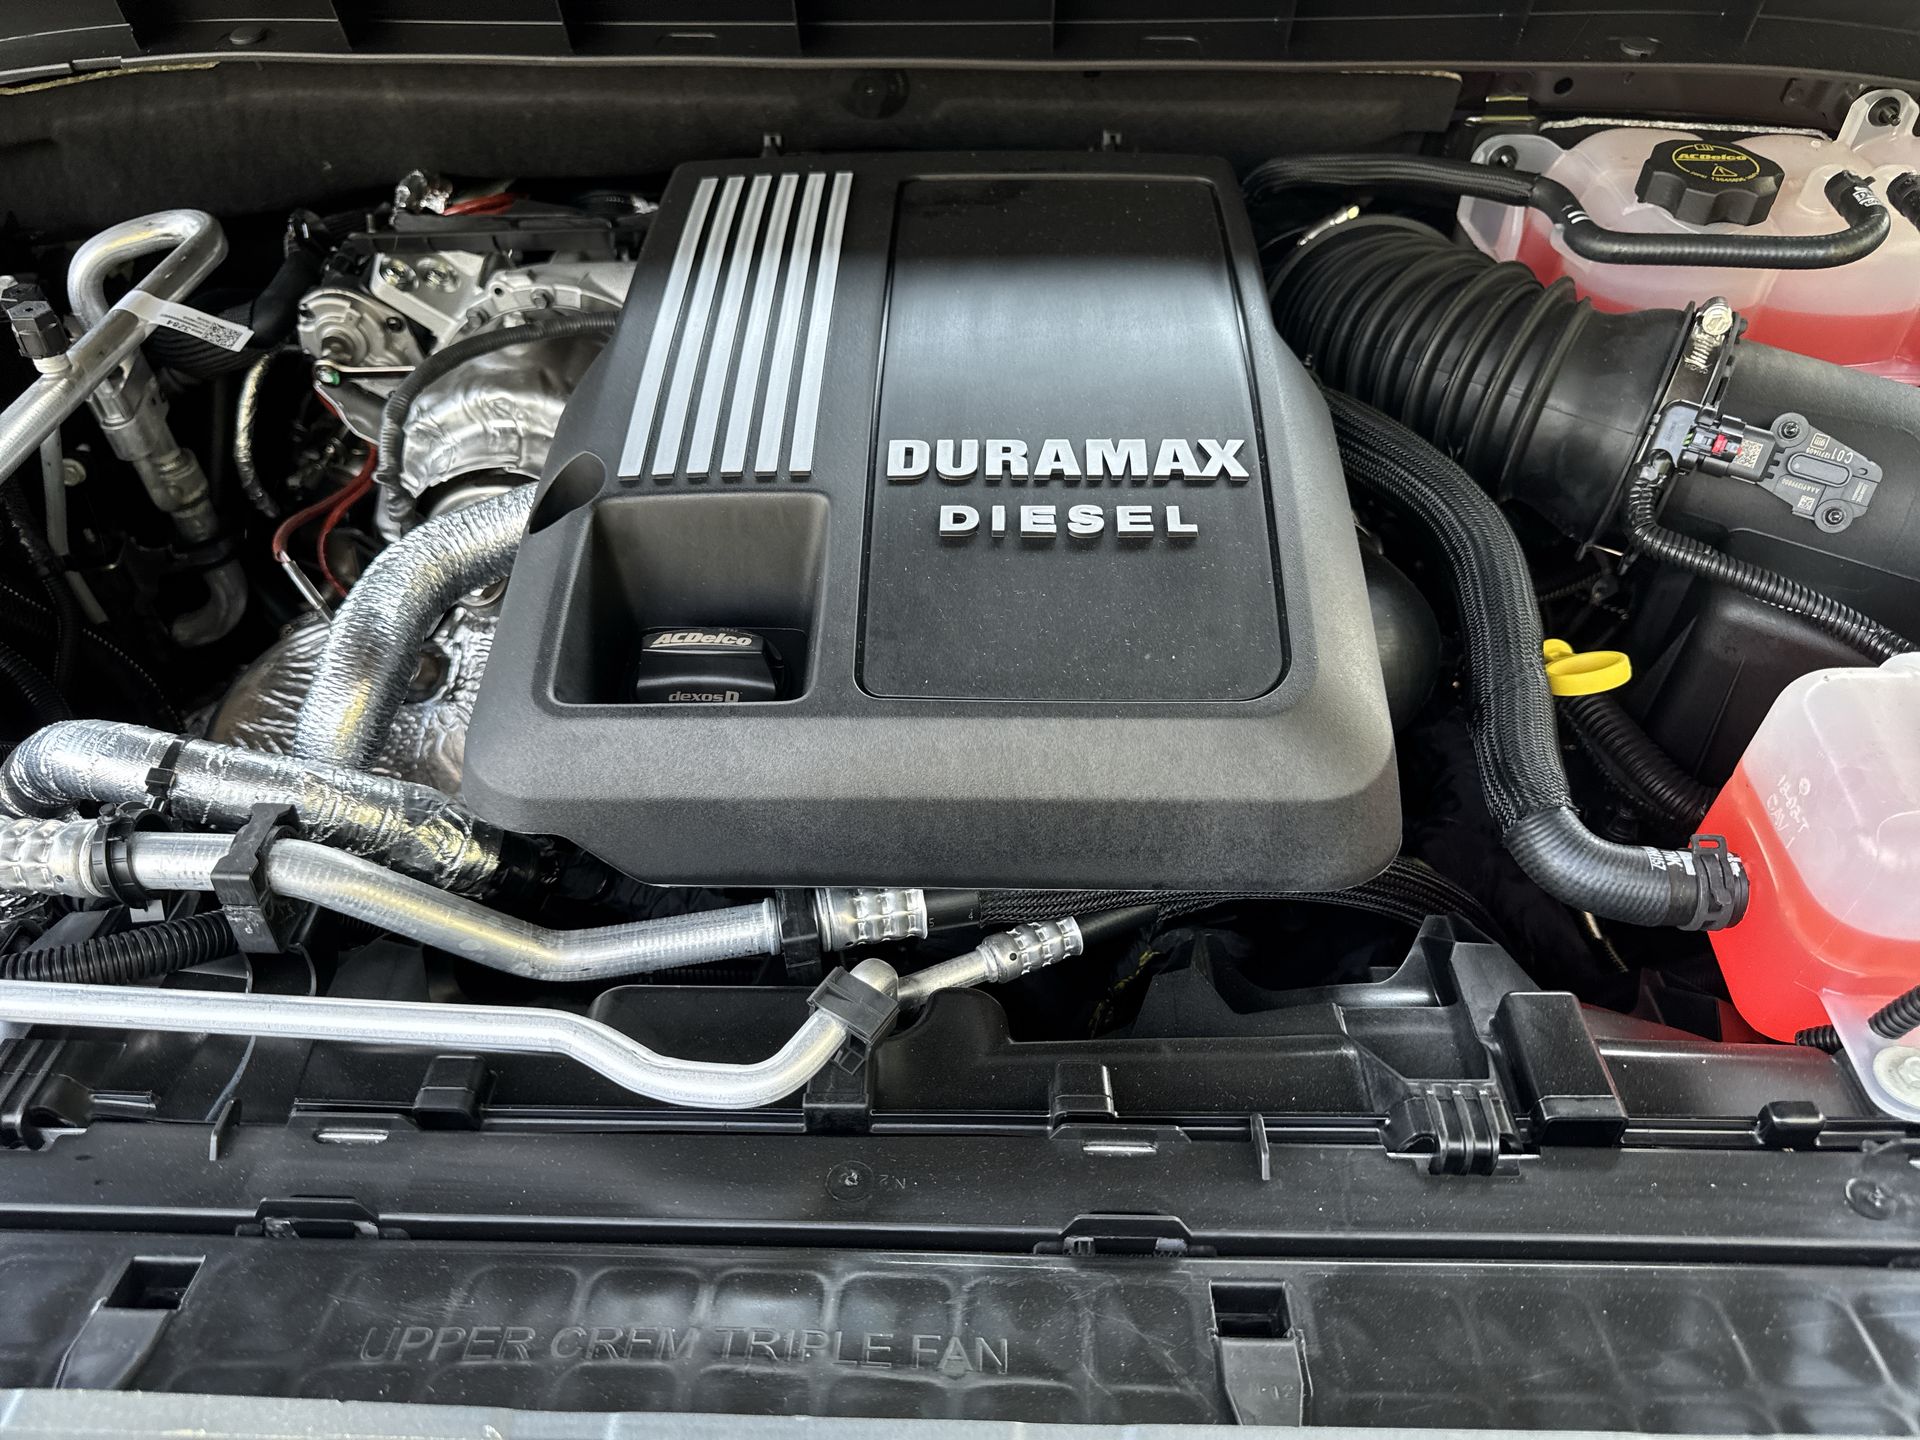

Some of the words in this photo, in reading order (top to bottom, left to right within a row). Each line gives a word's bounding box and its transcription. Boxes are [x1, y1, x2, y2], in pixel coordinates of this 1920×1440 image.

[1676, 152, 1747, 161] ACDelco
[887, 439, 1249, 481] DURAMAX
[1832, 447, 1853, 464] C01
[939, 505, 1199, 538] DIESEL
[651, 632, 753, 647] ACDelco
[359, 1326, 536, 1361] UPPER
[715, 1327, 894, 1368] TRIPLE
[911, 1334, 1009, 1374] FAN
